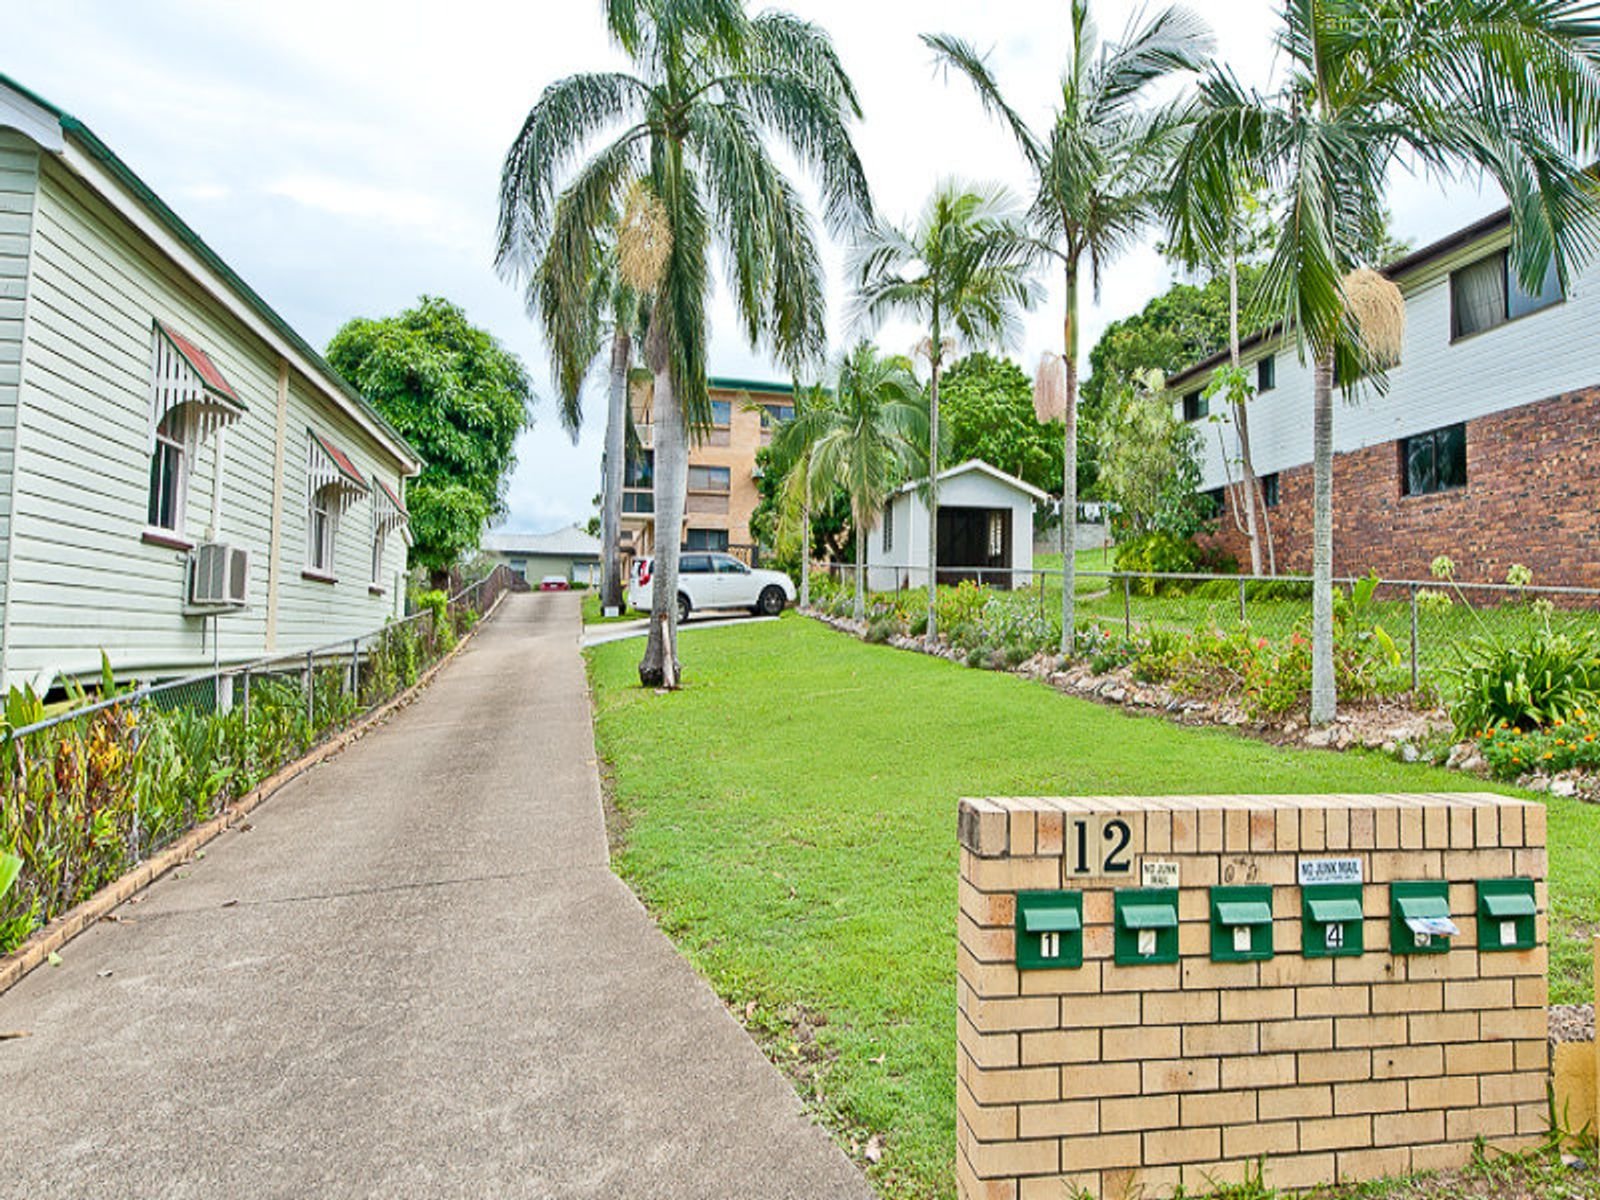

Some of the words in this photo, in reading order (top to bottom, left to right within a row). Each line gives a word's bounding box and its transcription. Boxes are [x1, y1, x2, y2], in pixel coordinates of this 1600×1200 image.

[1074, 819, 1131, 872] 12
[1144, 863, 1155, 873] NO
[1157, 863, 1177, 874] JUNK
[1302, 863, 1313, 876] NO
[1315, 862, 1337, 875] JUNK
[1338, 860, 1359, 874] MAIL
[1044, 933, 1053, 957] 1
[1328, 924, 1342, 947] 4
